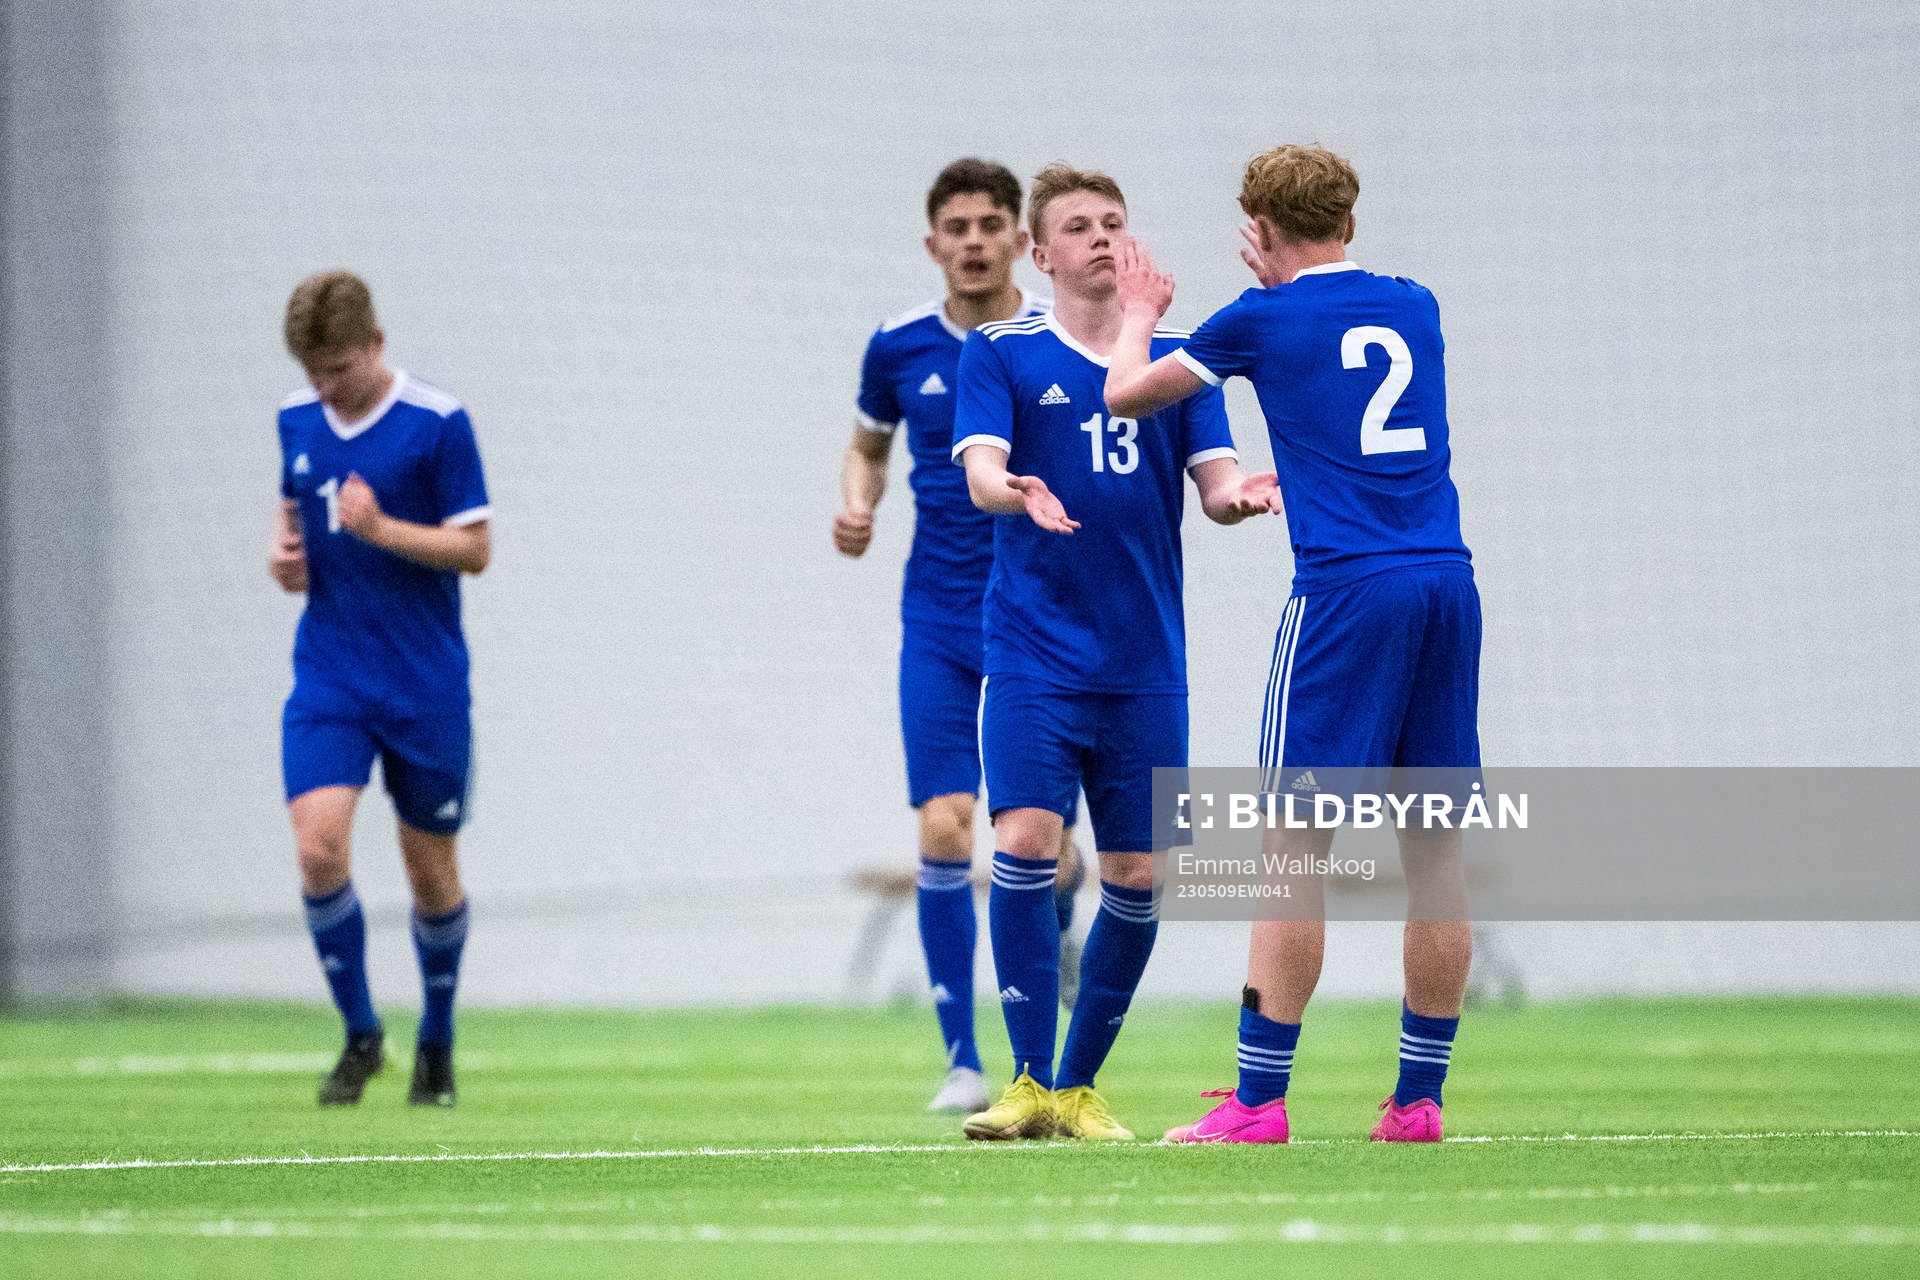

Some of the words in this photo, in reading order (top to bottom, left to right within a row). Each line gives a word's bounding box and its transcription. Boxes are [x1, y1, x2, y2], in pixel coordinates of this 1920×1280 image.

[1039, 396, 1070, 405] adidas
[1341, 325, 1427, 456] 2
[1080, 412, 1139, 475] 13
[316, 477, 341, 534] 1
[1291, 782, 1321, 792] adidas
